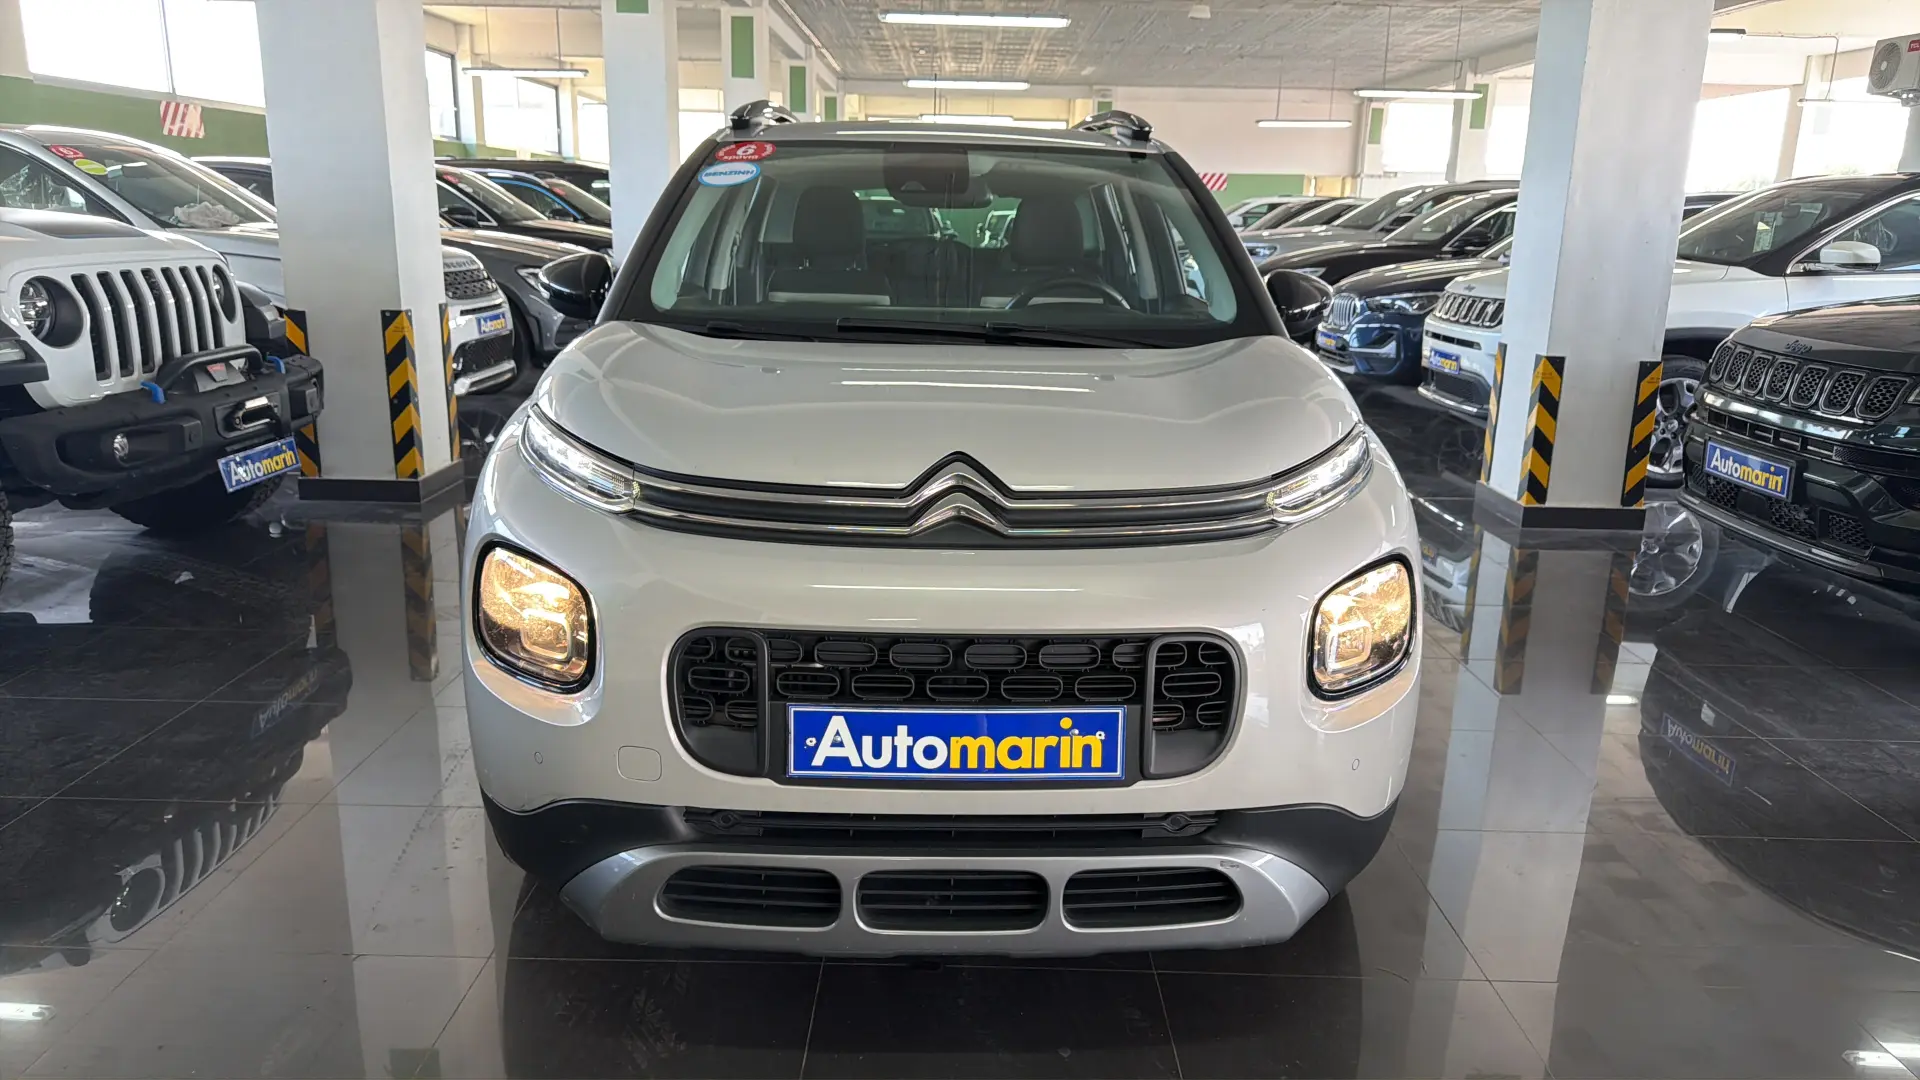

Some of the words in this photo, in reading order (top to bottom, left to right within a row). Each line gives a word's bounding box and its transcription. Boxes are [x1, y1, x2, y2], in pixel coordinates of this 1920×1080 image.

[736, 144, 757, 156] 6
[230, 445, 297, 486] Automarin
[1710, 448, 1783, 492] Automarin
[811, 715, 1102, 769] Automarin
